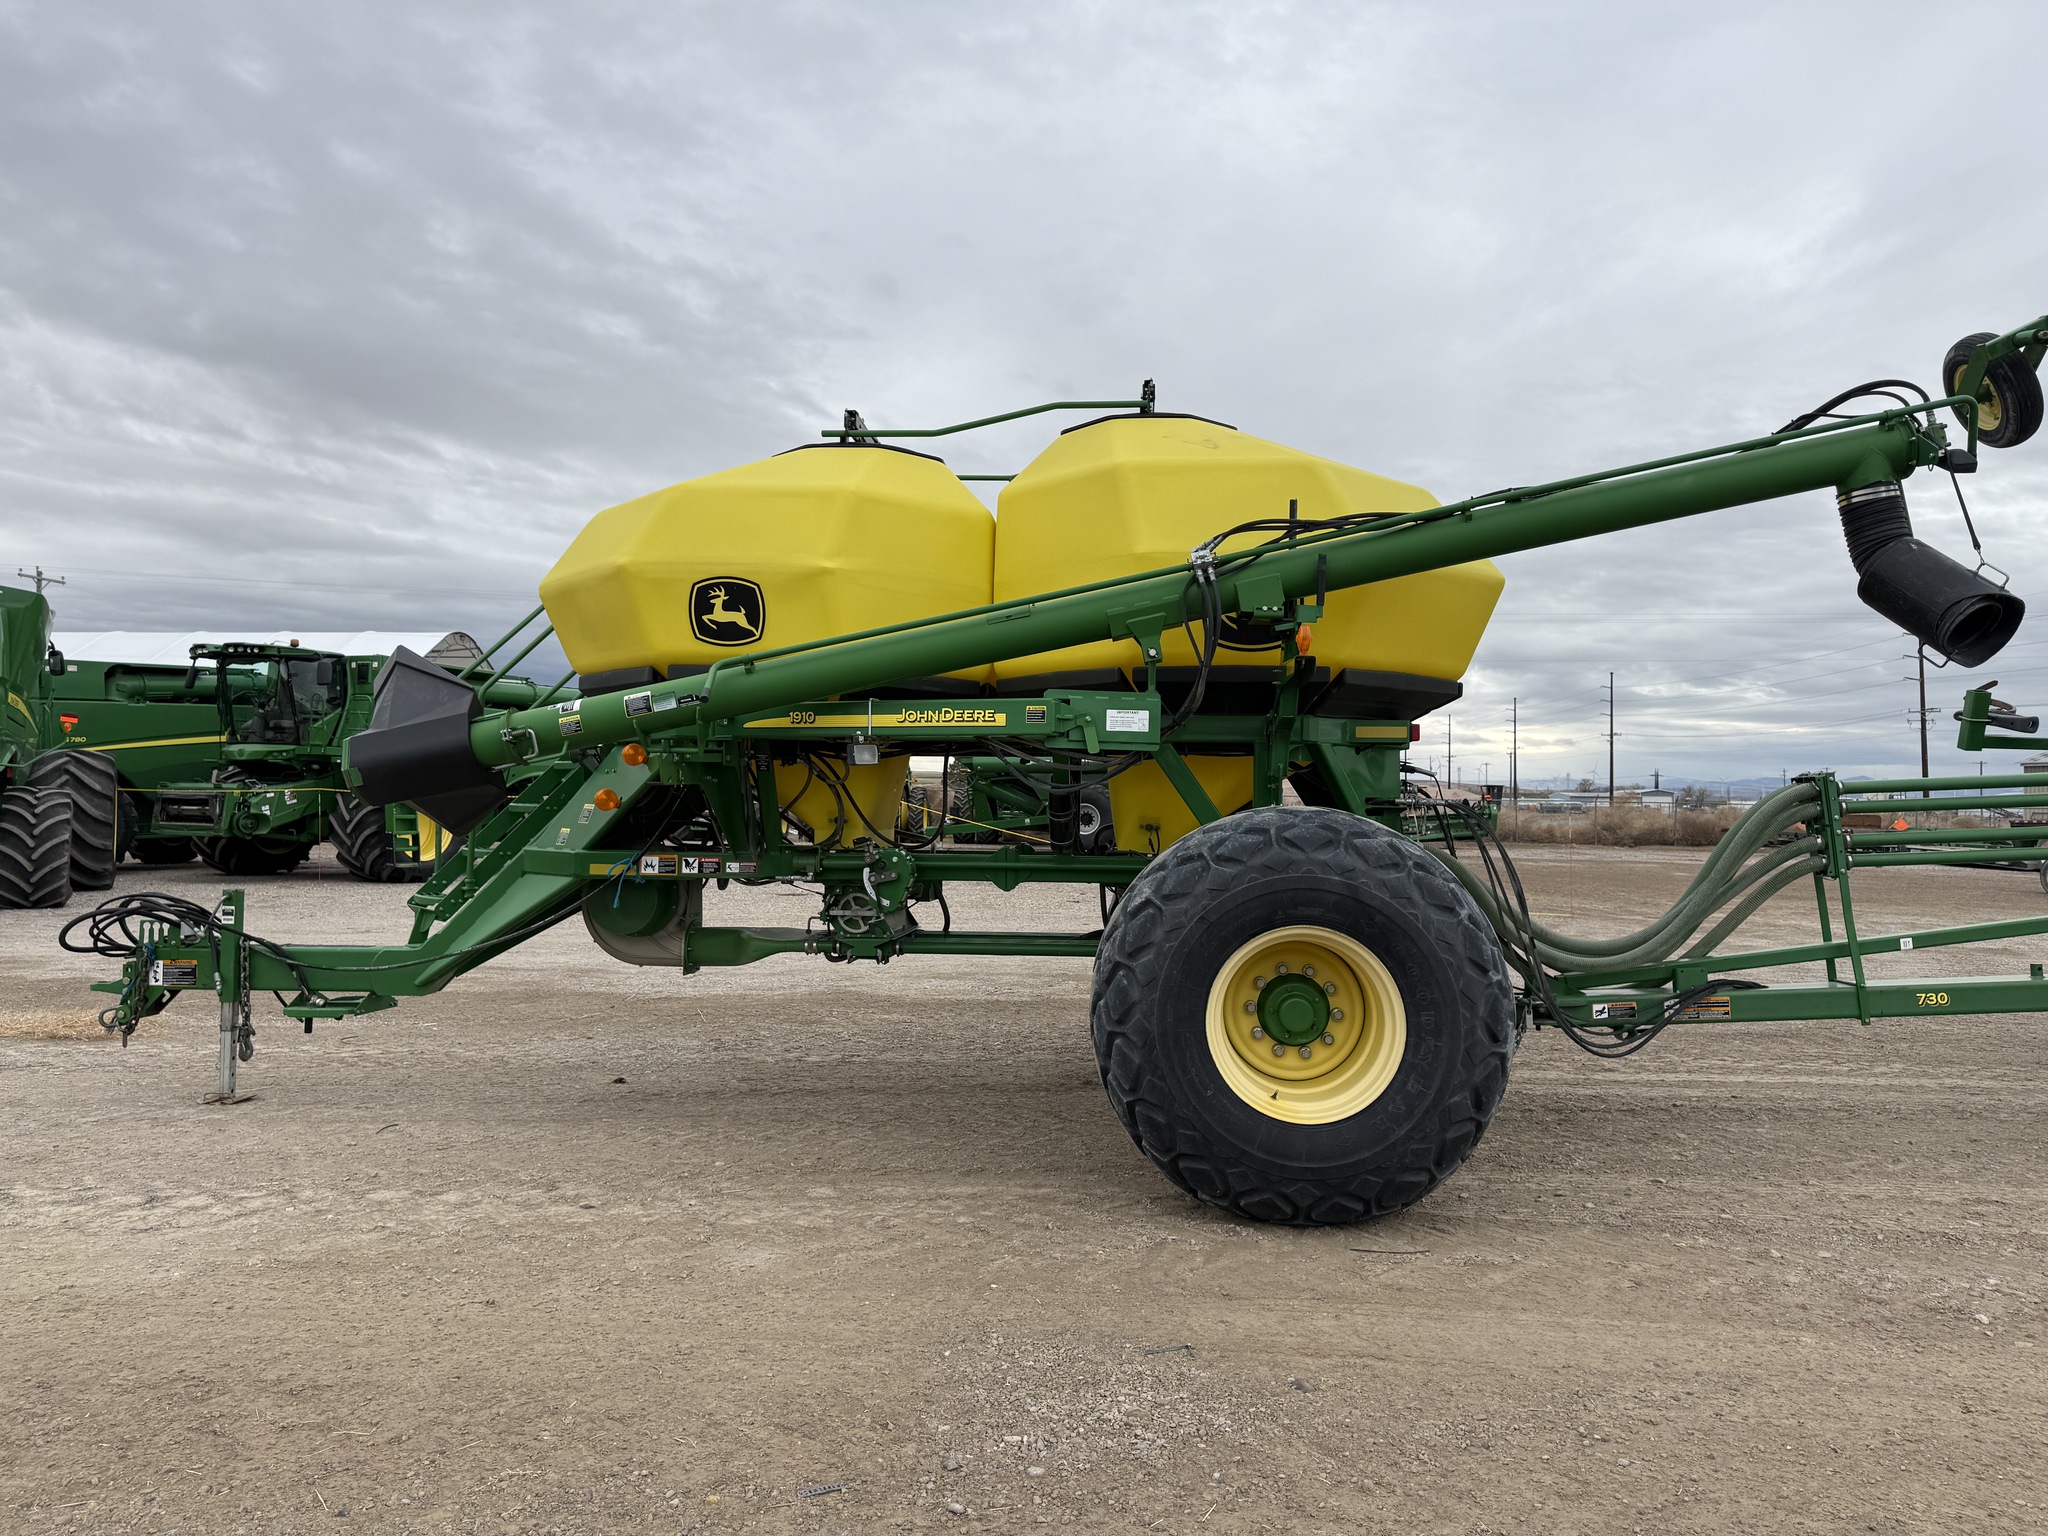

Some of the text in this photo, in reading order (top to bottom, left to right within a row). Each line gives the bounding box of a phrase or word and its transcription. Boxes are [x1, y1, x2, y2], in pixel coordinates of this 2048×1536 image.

[788, 711, 815, 725] 1910
[896, 708, 996, 723] JOHN DEERE
[1916, 993, 1950, 1007] 730
